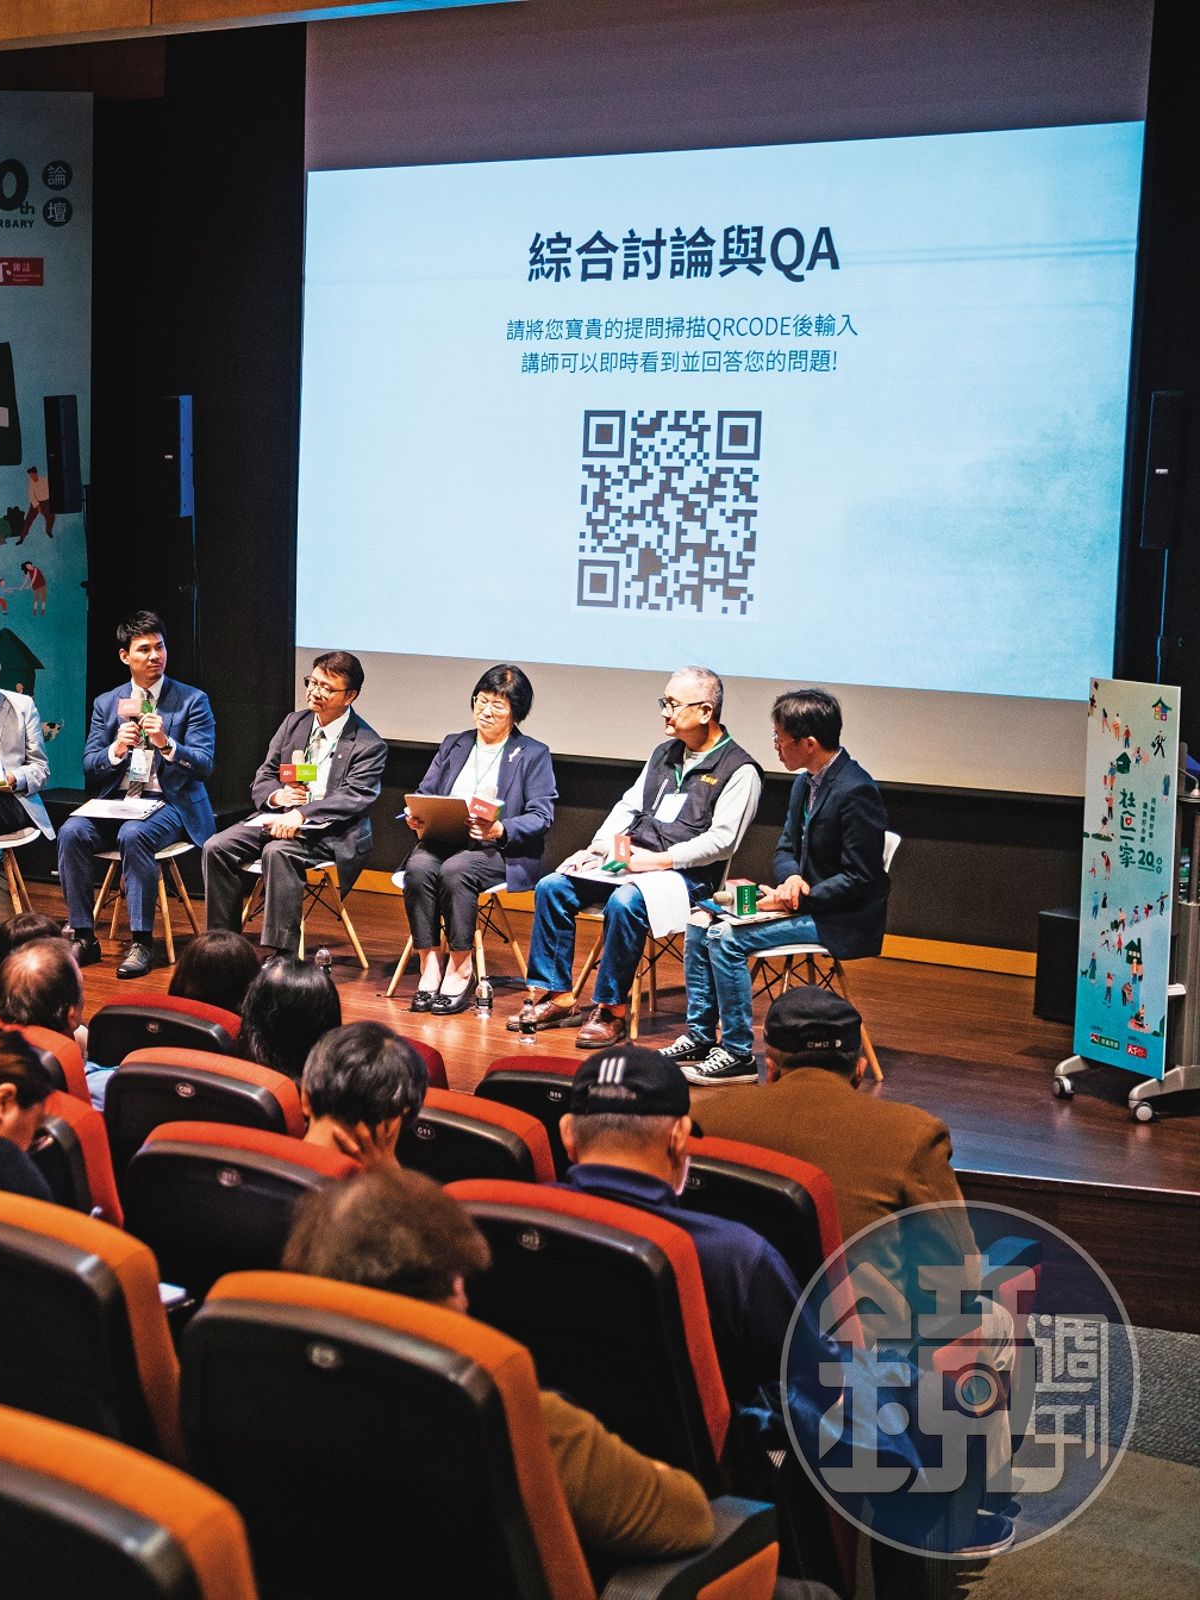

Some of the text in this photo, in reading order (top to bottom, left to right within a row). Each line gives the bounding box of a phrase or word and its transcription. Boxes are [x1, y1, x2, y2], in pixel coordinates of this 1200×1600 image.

[527, 224, 841, 283] 綜合討論與QA
[506, 313, 859, 342] 請將您寶貴的提問掃描QRCODE後輸入
